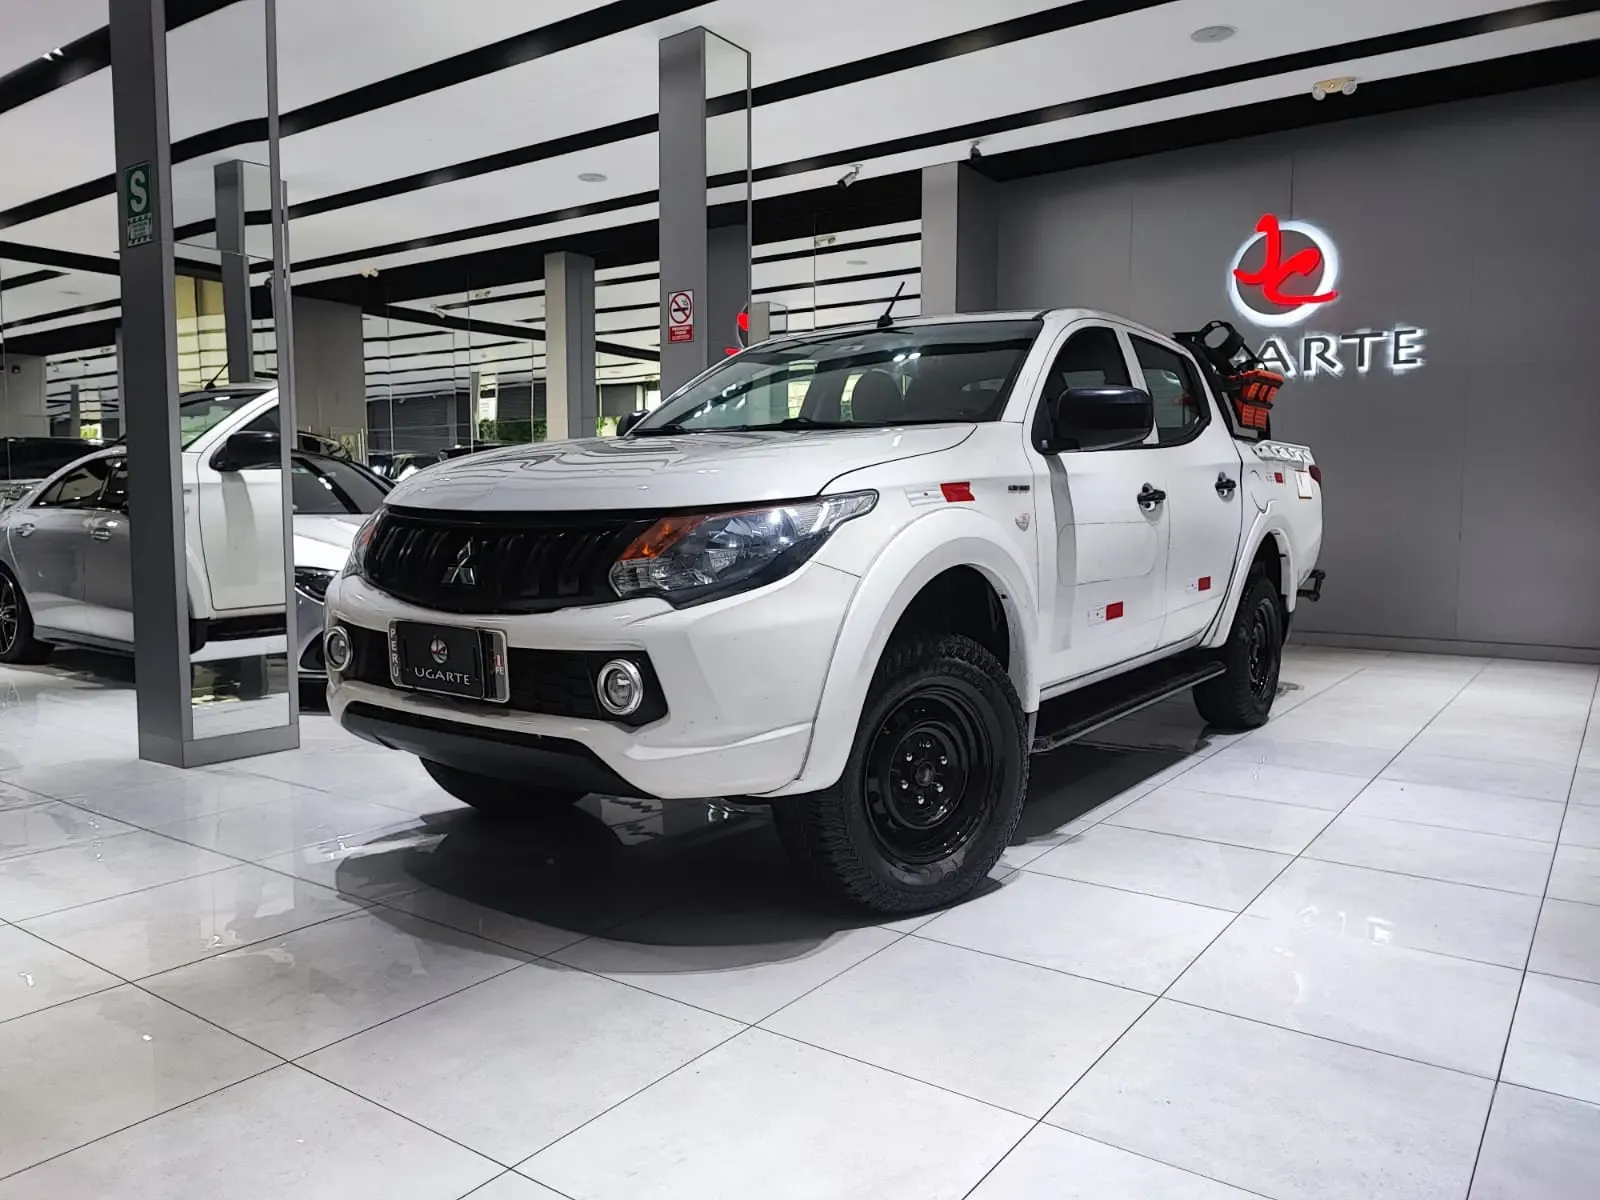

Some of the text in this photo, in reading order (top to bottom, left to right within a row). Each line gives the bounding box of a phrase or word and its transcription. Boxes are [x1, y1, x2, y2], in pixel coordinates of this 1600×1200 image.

[130, 170, 147, 213] S
[1236, 326, 1425, 377] ARTE
[390, 627, 400, 677] PERU
[414, 667, 471, 686] UGARTE
